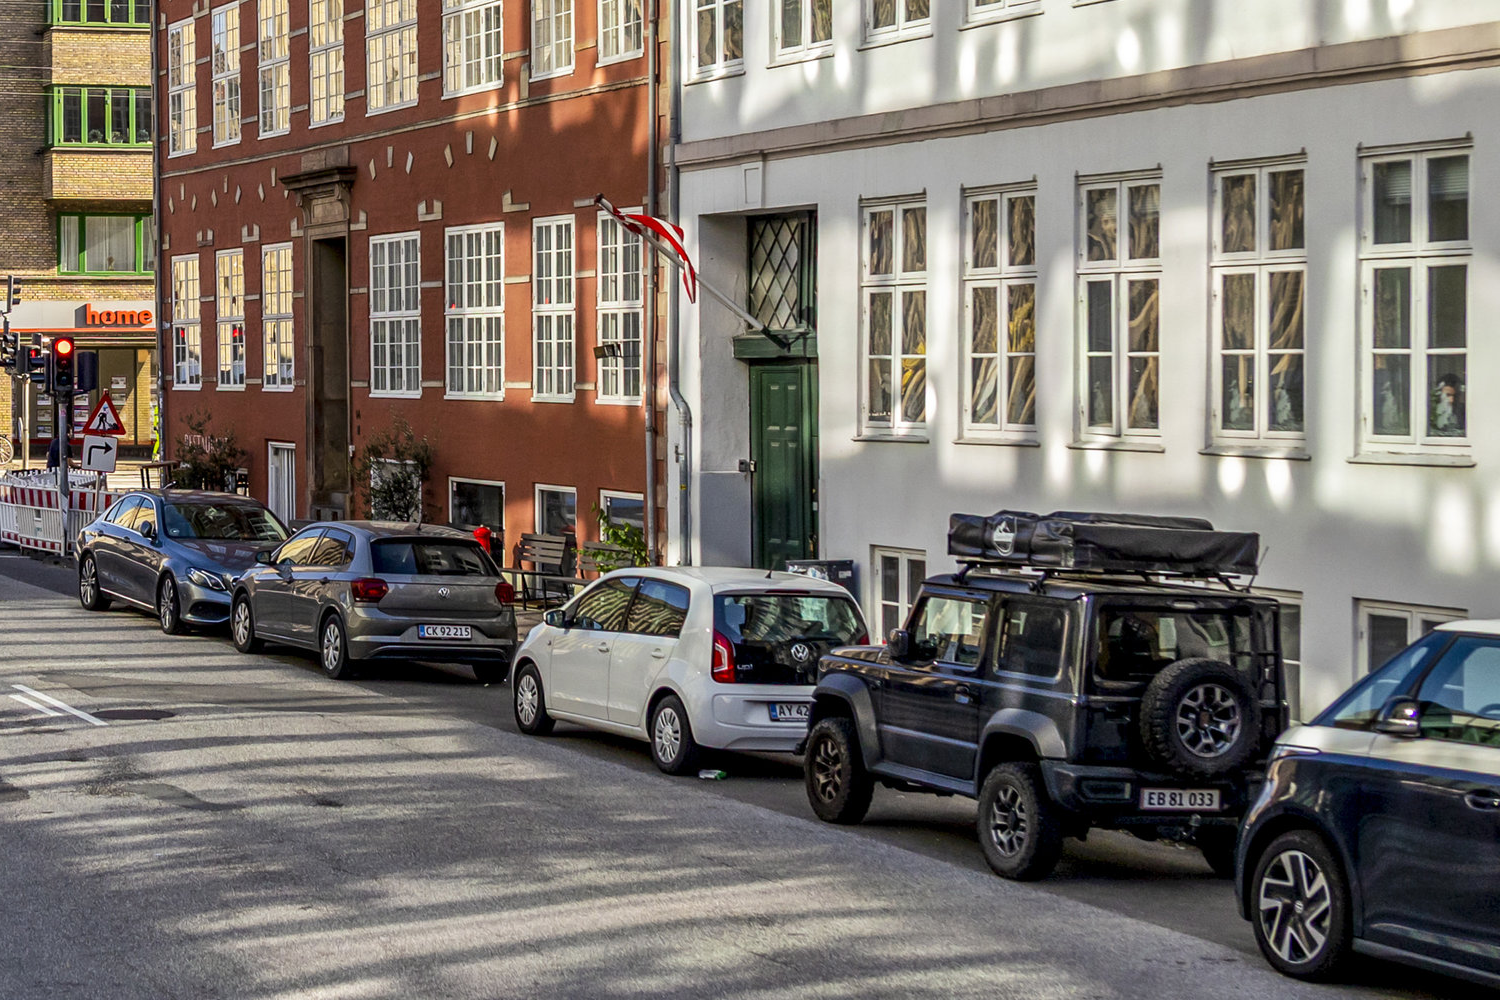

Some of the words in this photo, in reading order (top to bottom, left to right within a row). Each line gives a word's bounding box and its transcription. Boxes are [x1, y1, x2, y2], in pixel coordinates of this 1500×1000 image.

[86, 303, 153, 326] home
[426, 626, 438, 636] CK
[440, 626, 452, 636] 92
[453, 627, 470, 637] 215
[779, 704, 793, 717] AY
[1148, 791, 1166, 806] EB
[1169, 791, 1184, 807] 81
[1189, 792, 1214, 807] 033
